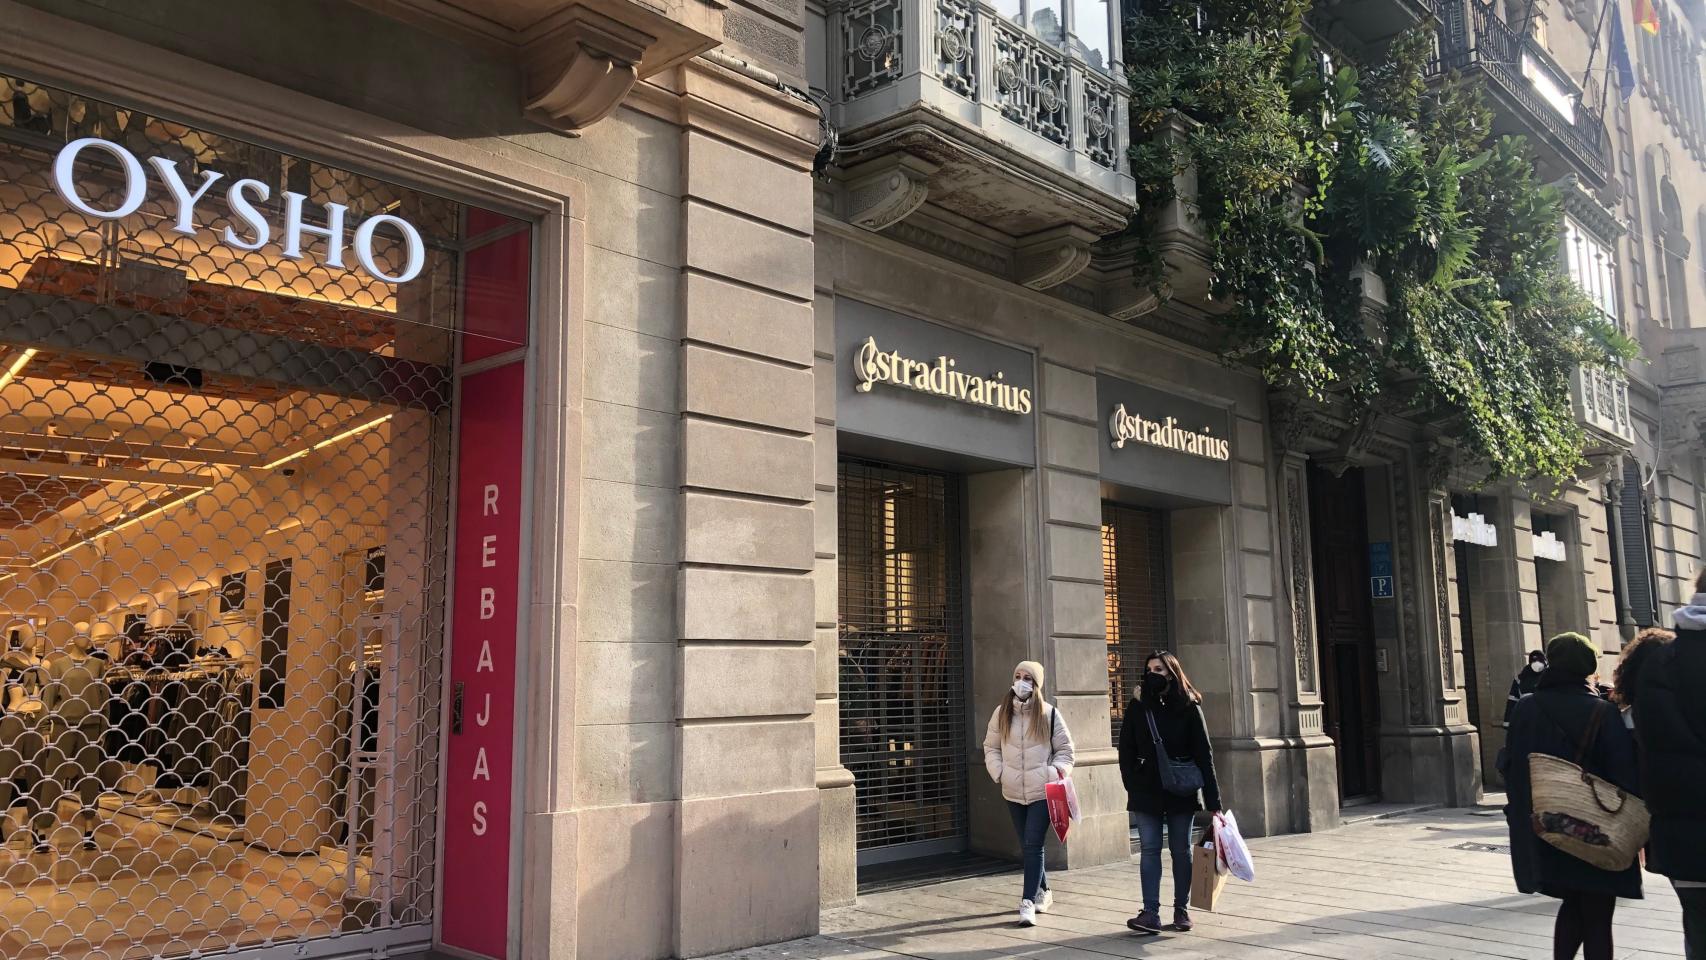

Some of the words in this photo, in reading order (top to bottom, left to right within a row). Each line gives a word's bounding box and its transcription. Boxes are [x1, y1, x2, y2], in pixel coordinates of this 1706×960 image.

[52, 137, 425, 283] OYSHO
[874, 348, 1032, 415] stradivarius
[1124, 412, 1230, 461] stradivarius
[1377, 578, 1387, 592] P
[471, 483, 500, 836] REBAJAS
